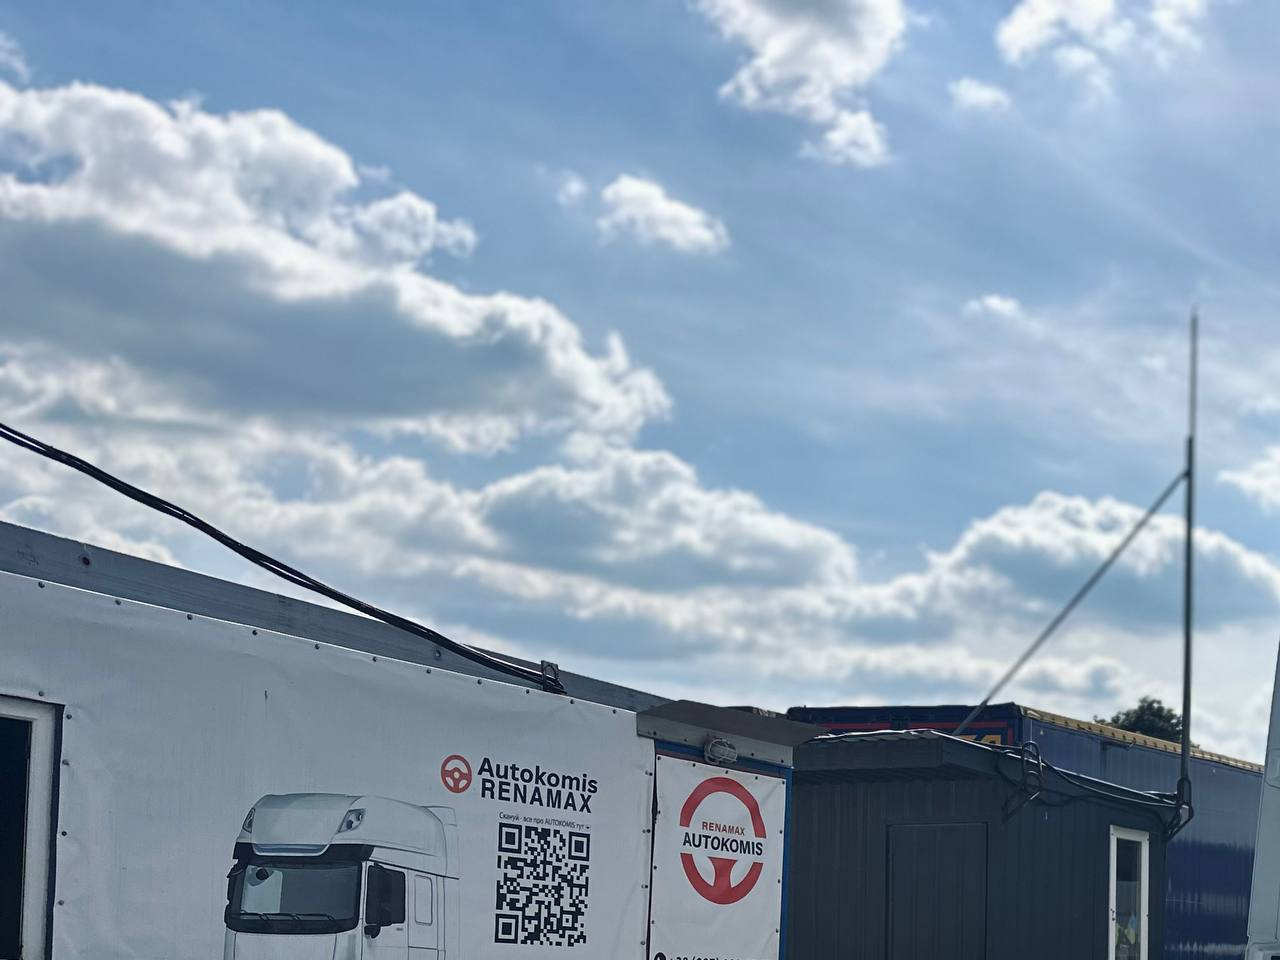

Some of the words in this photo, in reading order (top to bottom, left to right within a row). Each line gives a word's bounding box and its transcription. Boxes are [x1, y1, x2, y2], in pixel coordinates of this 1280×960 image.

[477, 757, 599, 794] Autokomis
[480, 778, 592, 813] RENAMAX
[545, 818, 576, 829] AUTOKOMIS
[702, 821, 745, 836] RENAMAX
[683, 832, 764, 856] AUTOKOMIS
